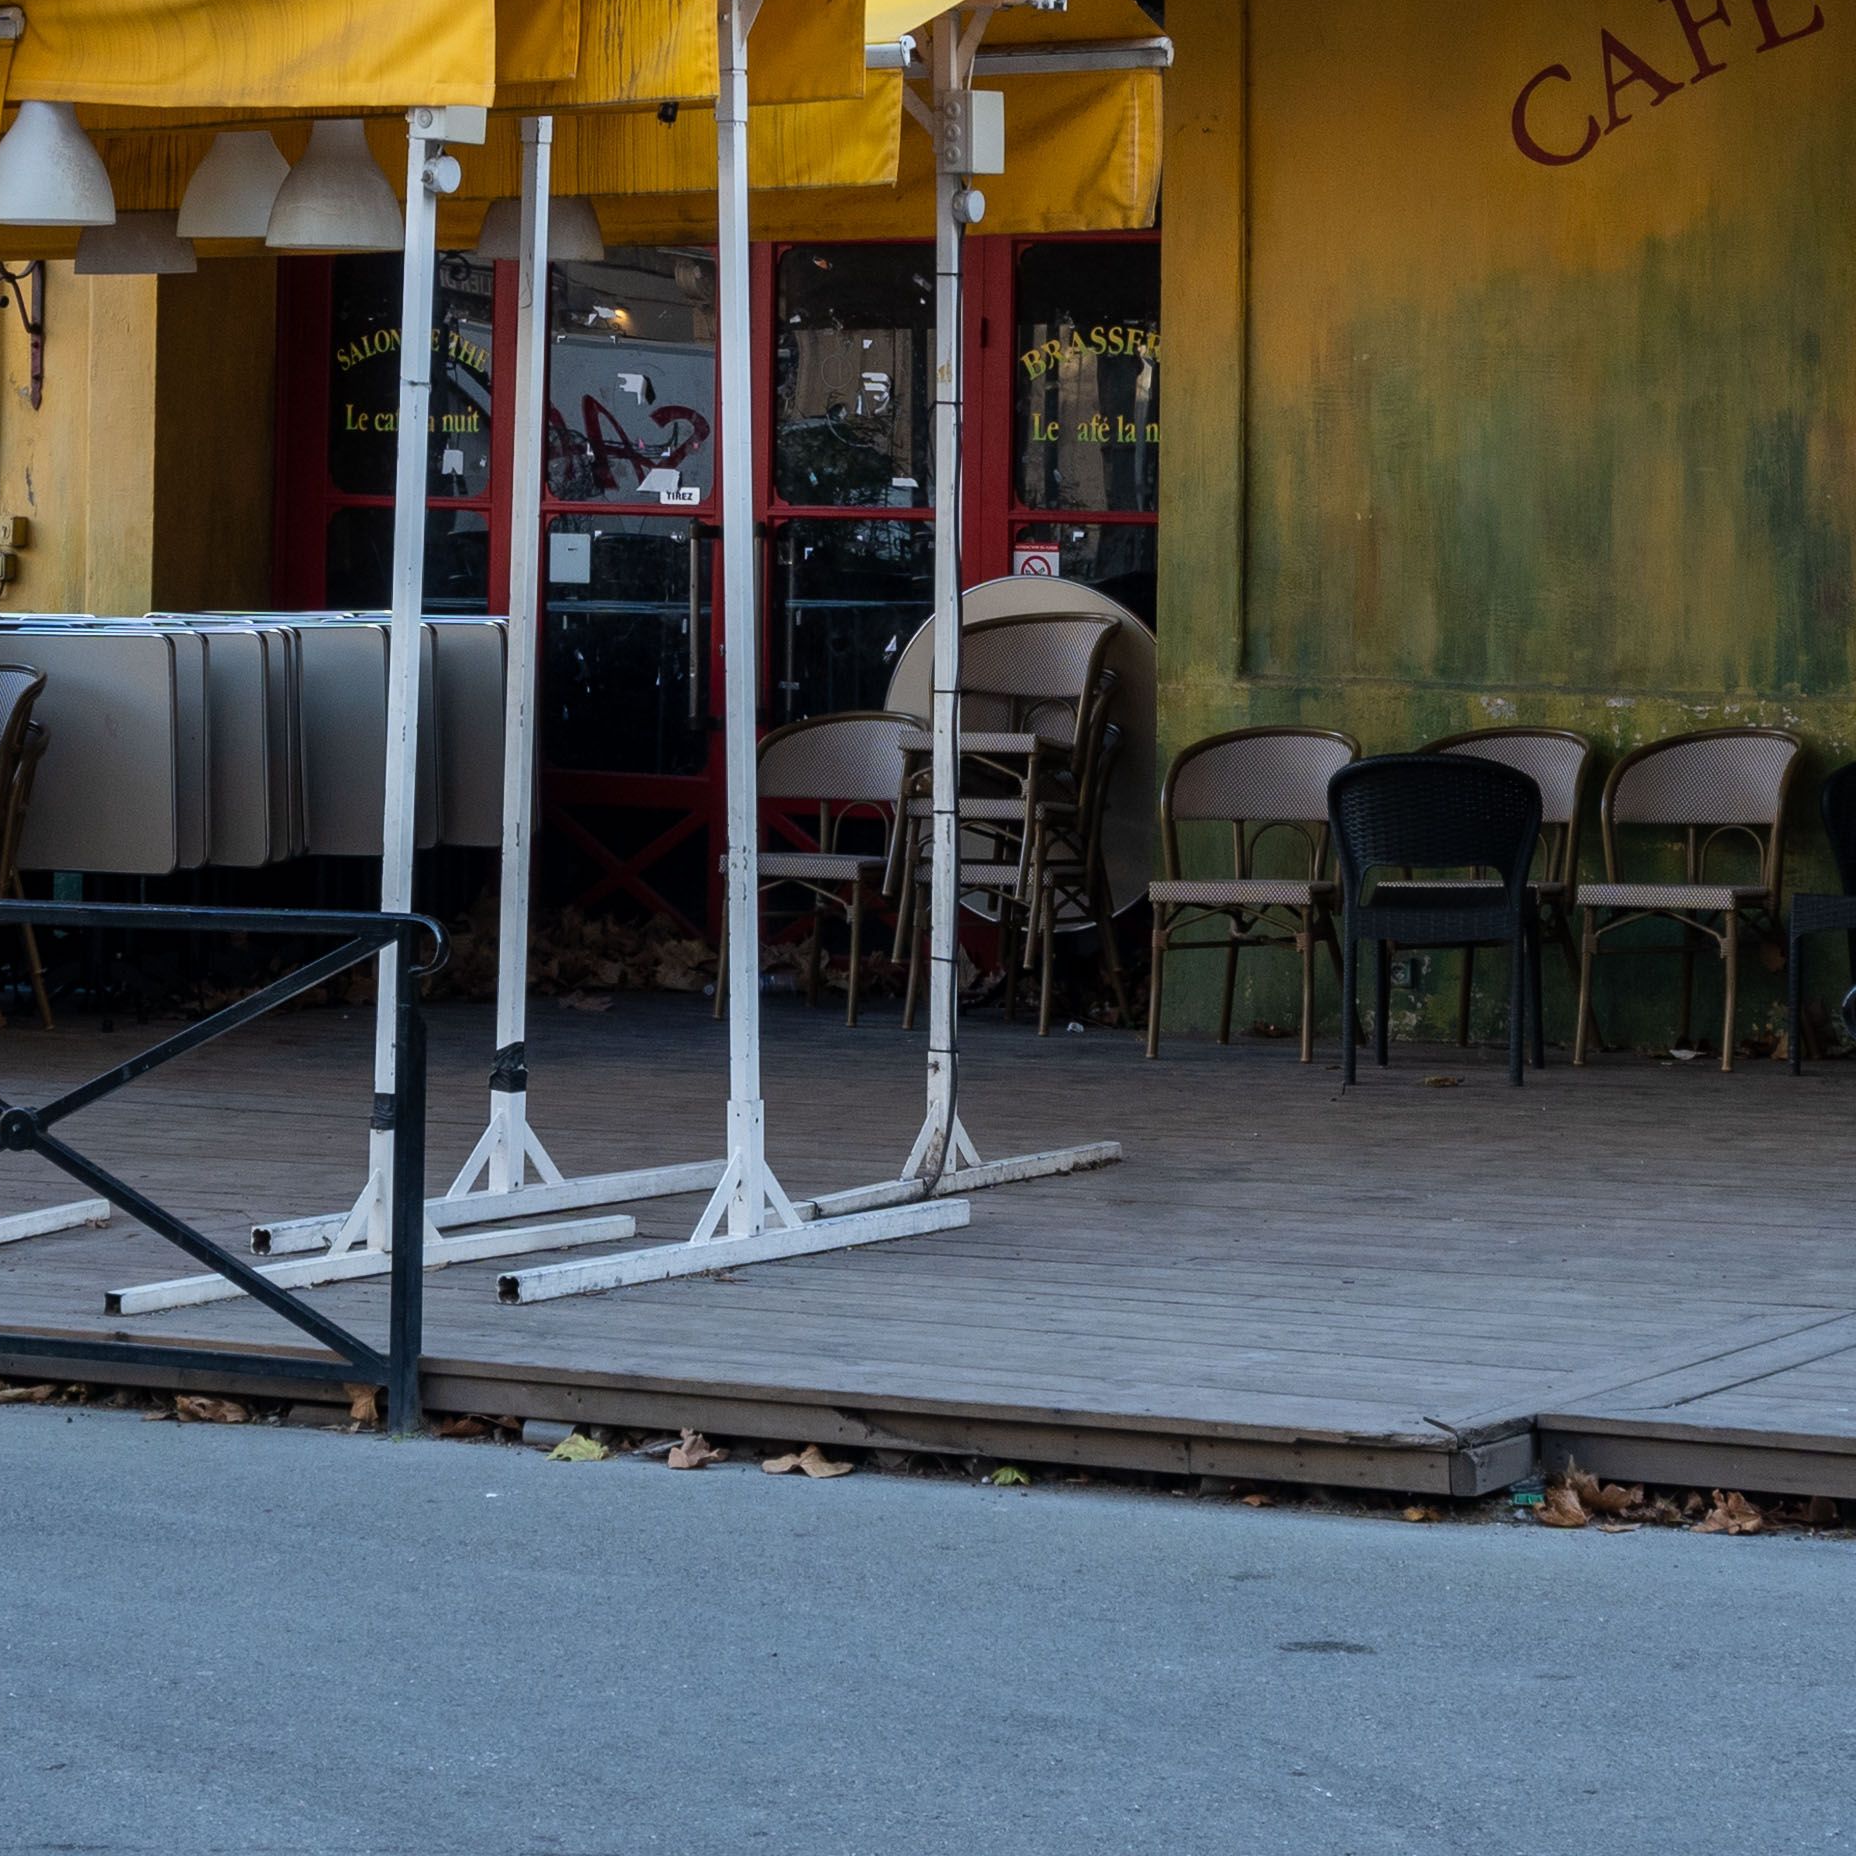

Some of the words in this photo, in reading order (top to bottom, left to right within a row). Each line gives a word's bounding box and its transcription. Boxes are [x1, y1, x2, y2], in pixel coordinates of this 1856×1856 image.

[343, 402, 370, 432] Le
[441, 404, 481, 433] nuit
[1031, 412, 1060, 442] Le
[1115, 413, 1137, 443] la
[666, 490, 694, 503] TIREZ
